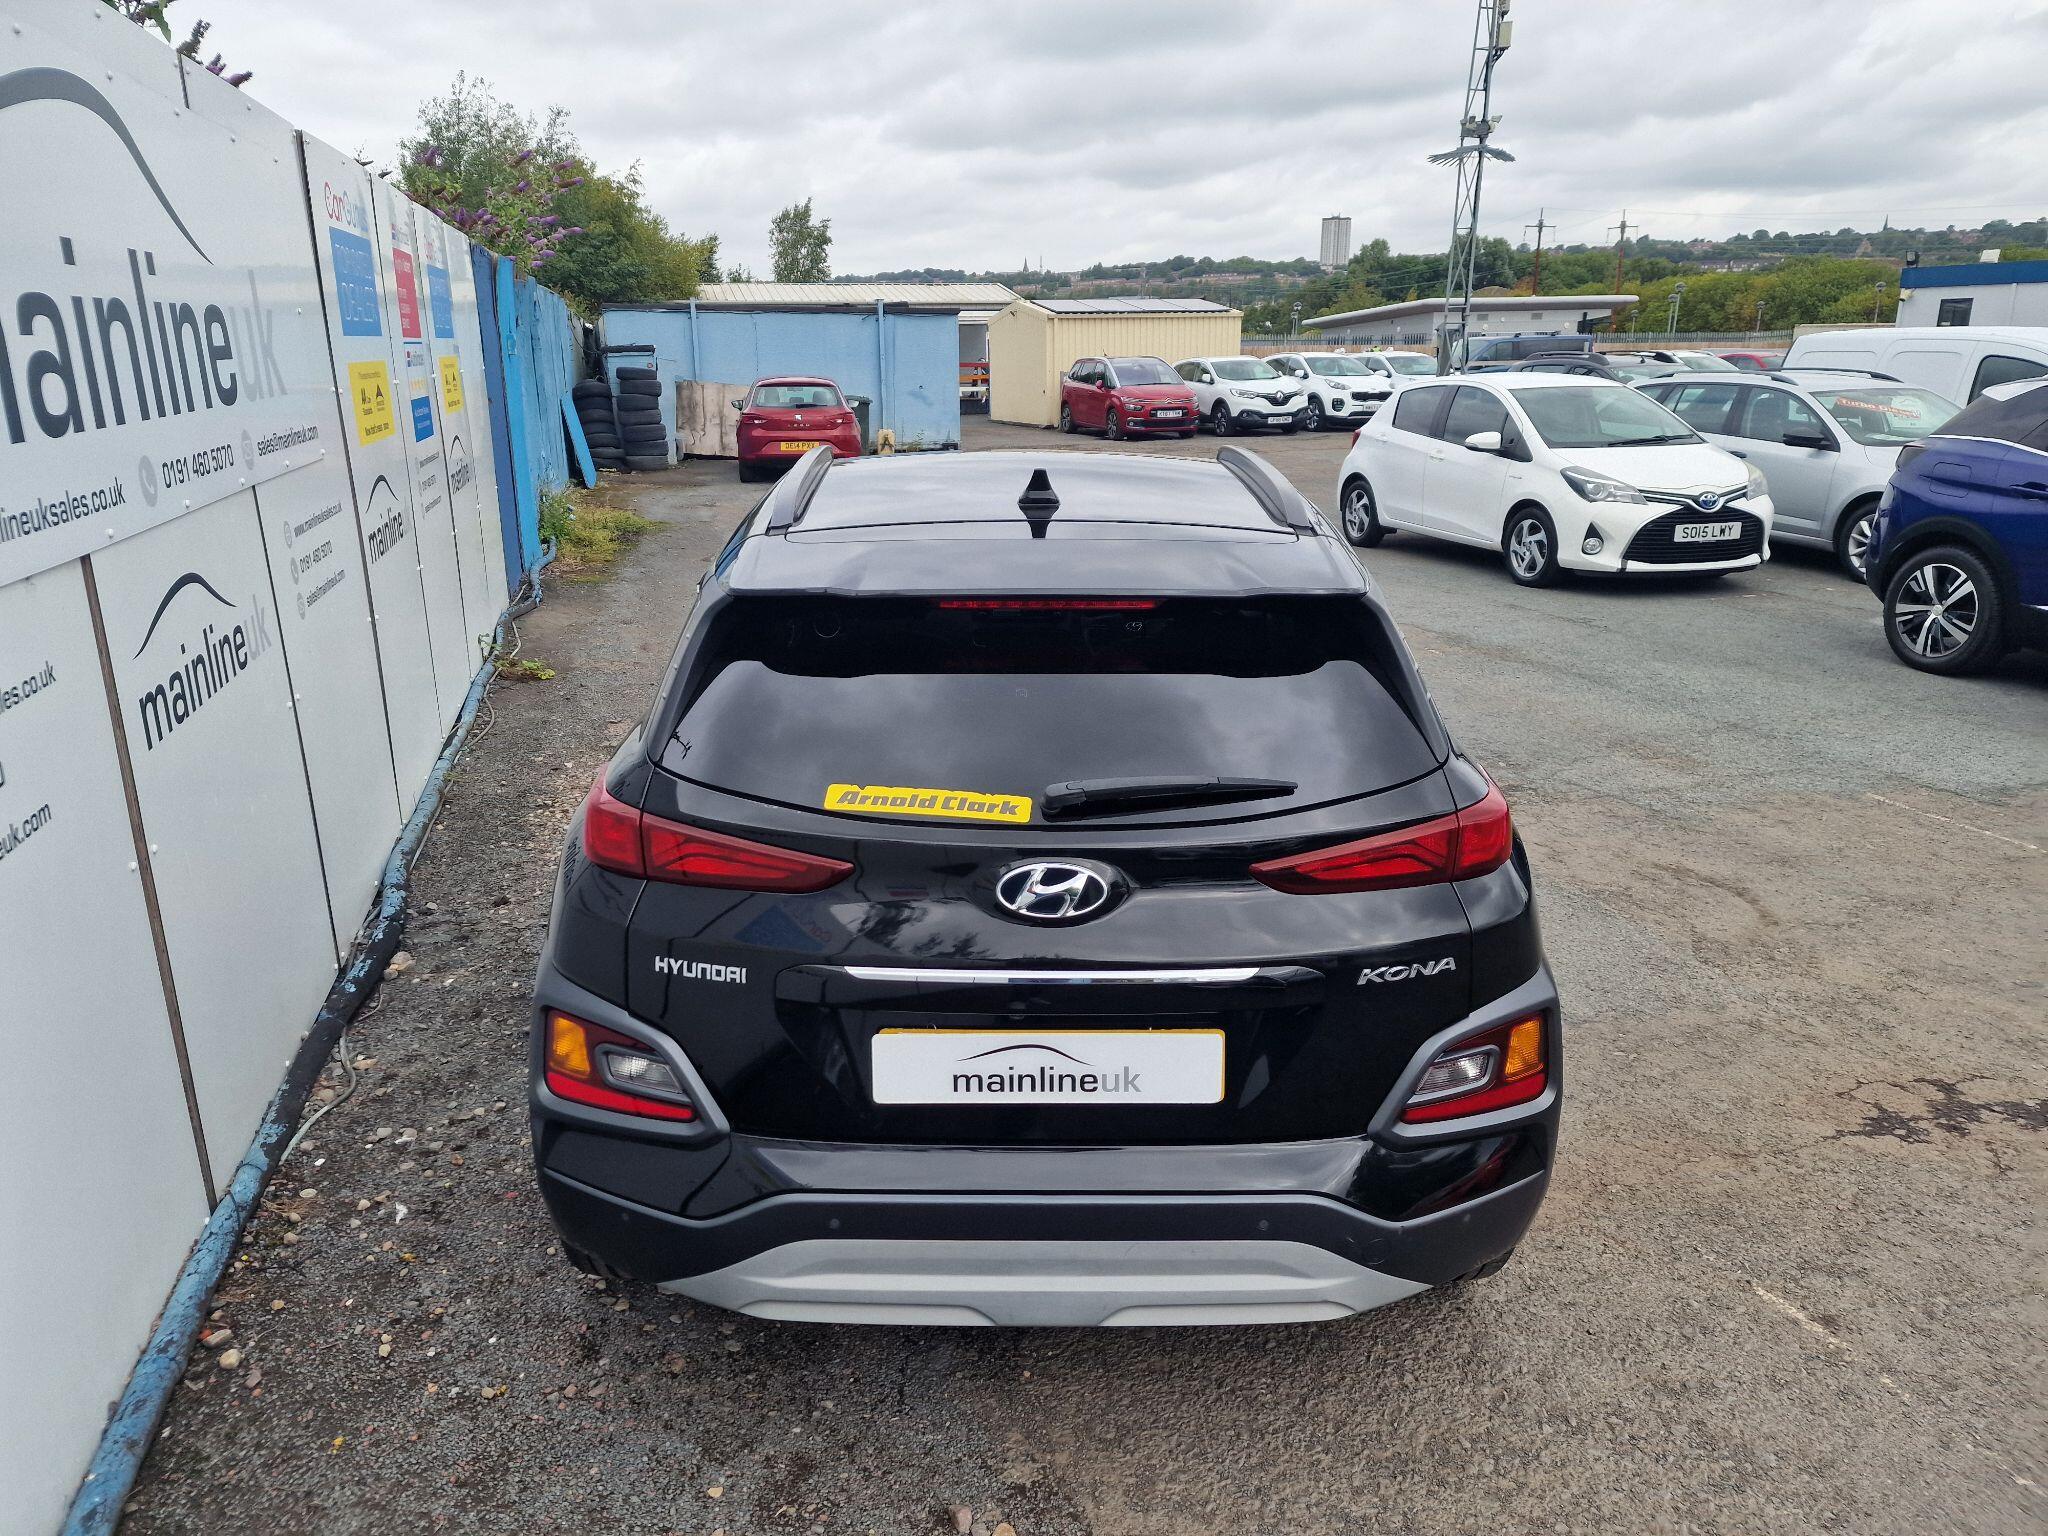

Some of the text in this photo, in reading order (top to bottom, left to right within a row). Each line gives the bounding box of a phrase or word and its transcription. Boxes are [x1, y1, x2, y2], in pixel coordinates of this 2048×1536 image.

[162, 456, 191, 489] 0191
[192, 450, 211, 478] 460
[211, 444, 235, 474] 5070
[1682, 524, 1735, 539] SO15 LWY
[139, 595, 271, 750] mainlineuk
[837, 790, 1020, 816] Arnold Clark
[655, 956, 747, 984] HYUNDAI
[1357, 957, 1456, 985] KONA
[953, 1066, 1142, 1093] mainlineuk
